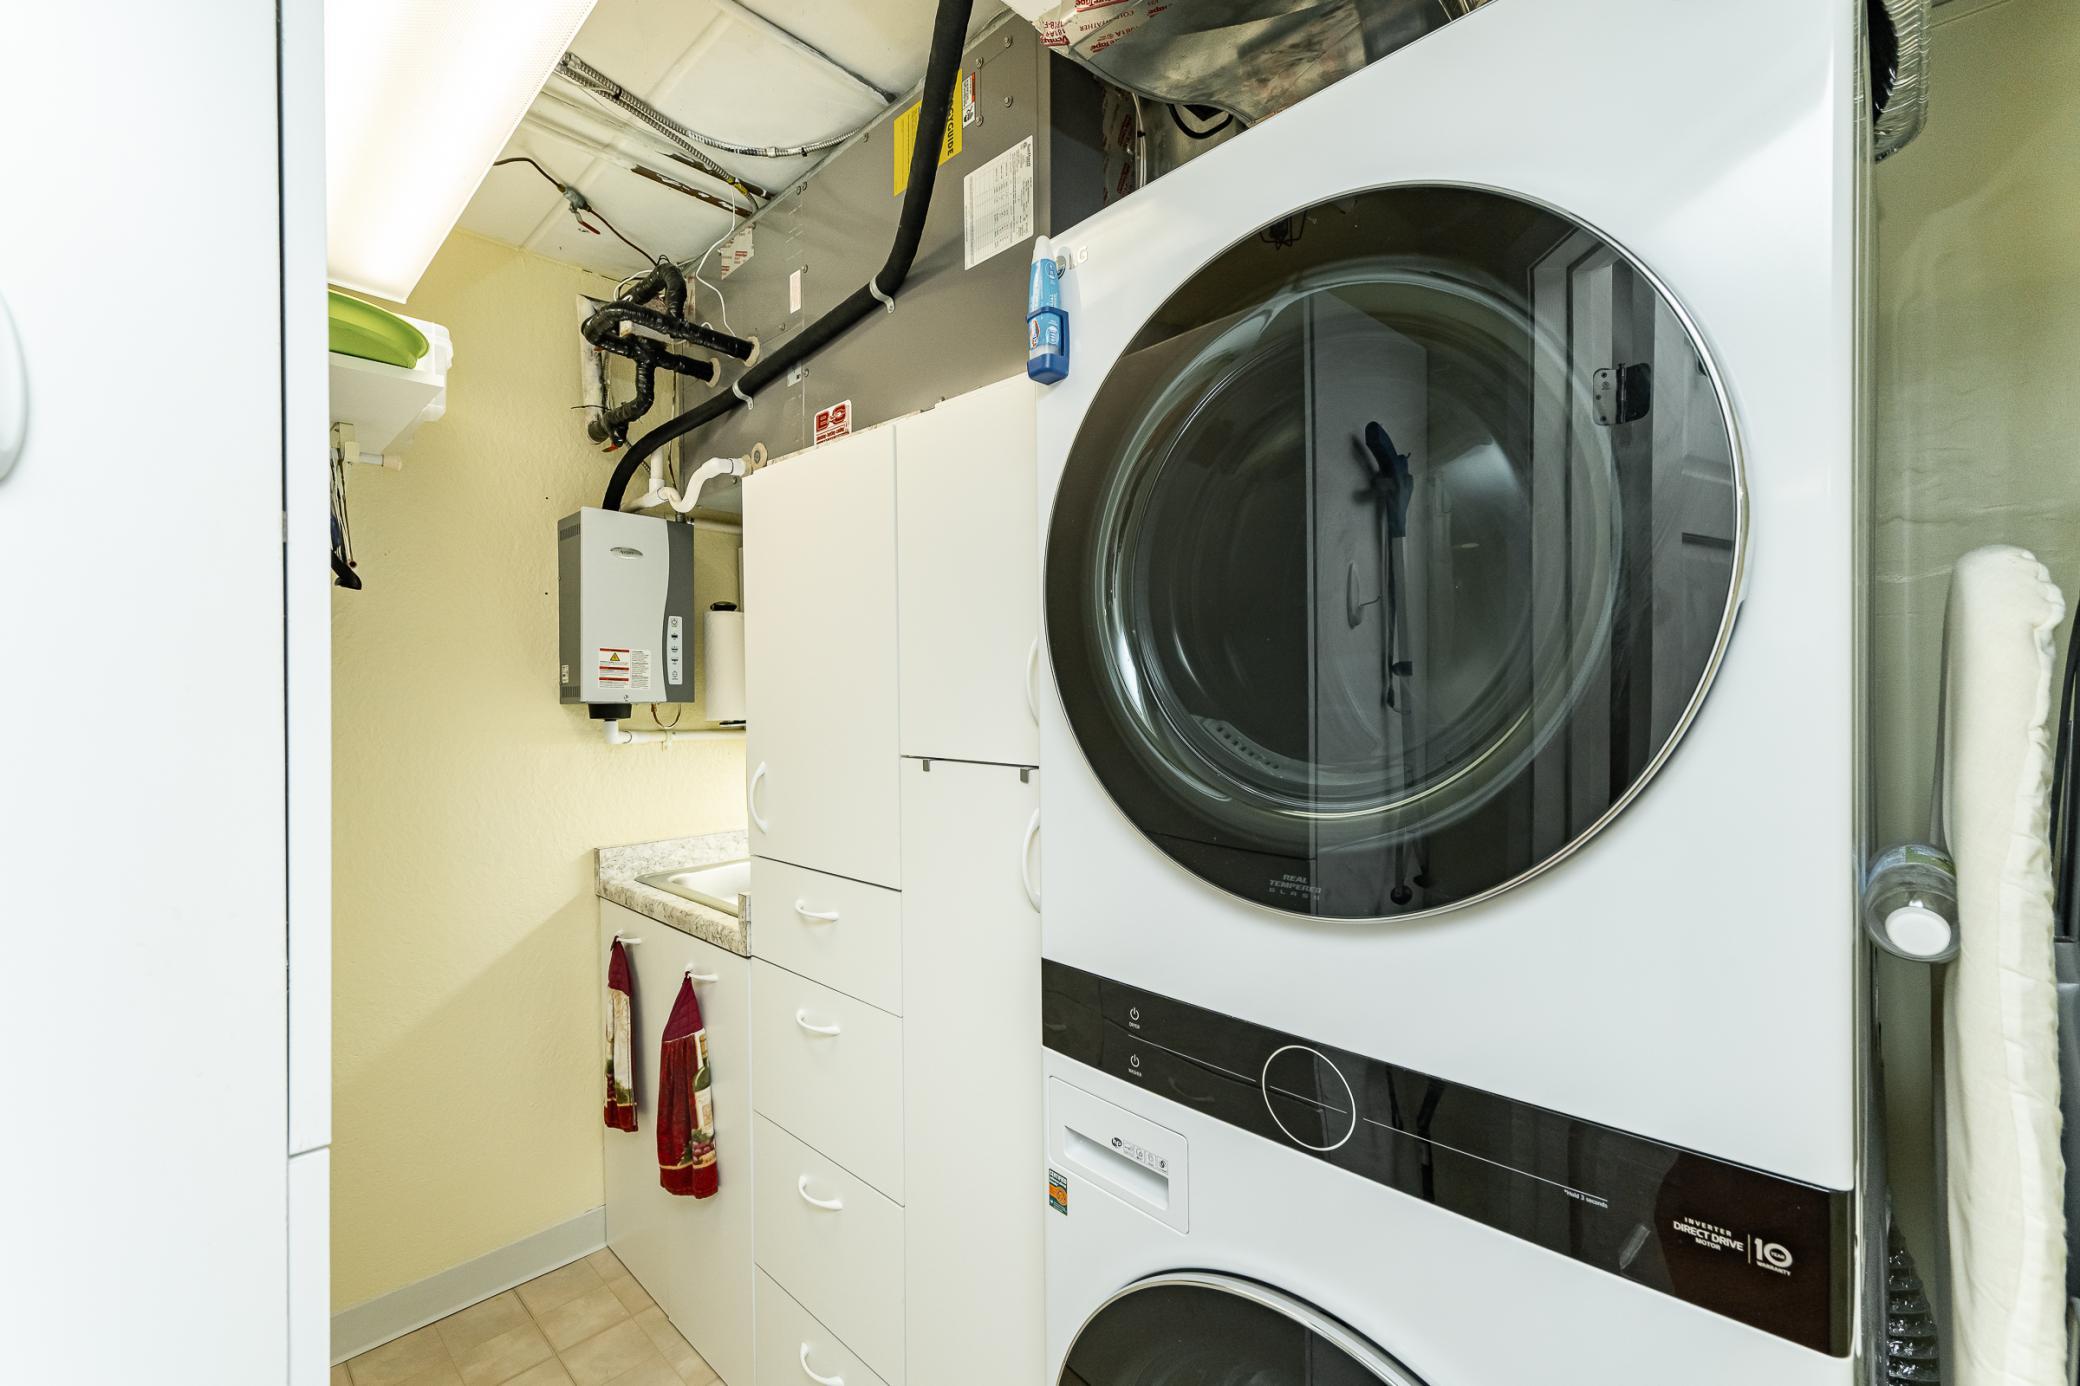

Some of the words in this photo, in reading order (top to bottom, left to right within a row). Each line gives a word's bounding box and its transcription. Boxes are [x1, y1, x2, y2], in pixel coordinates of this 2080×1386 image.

[1069, 246, 1088, 270] LG
[1270, 879, 1321, 893] TEMPERED
[1673, 1220, 1710, 1240] DIRECT
[1711, 1233, 1744, 1252] DRIVE
[1684, 1216, 1732, 1237] INVERTER
[1695, 1237, 1721, 1251] MOTOR
[1754, 1237, 1793, 1269] 10
